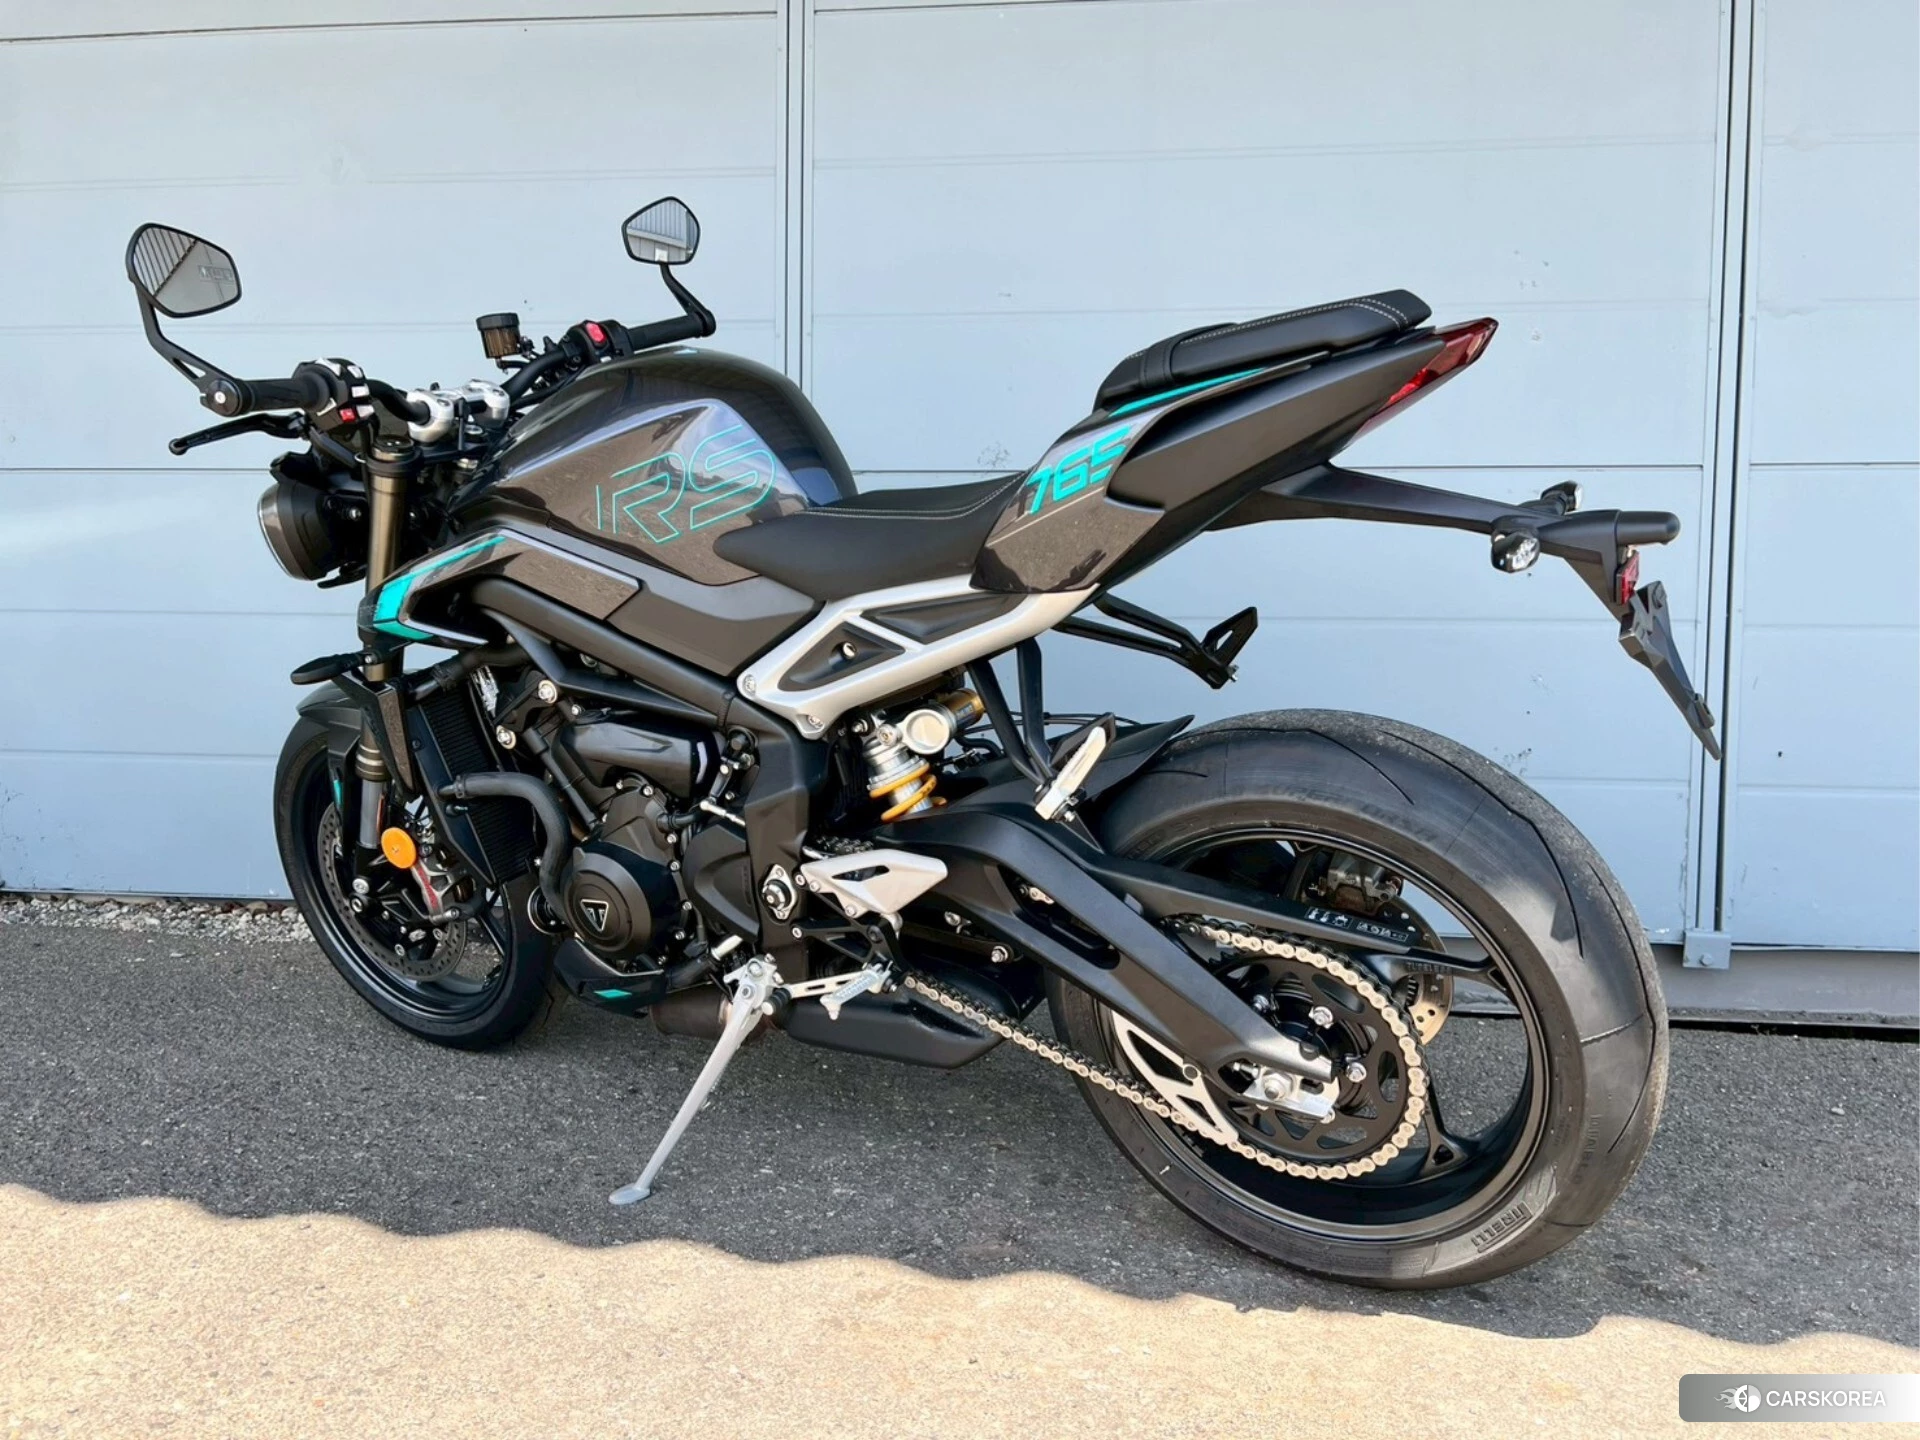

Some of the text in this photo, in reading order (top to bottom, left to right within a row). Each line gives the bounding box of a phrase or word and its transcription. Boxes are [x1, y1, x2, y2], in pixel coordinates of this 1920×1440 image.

[596, 424, 777, 544] RS
[1025, 424, 1132, 515] 765
[1470, 1200, 1534, 1253] PIRELLI
